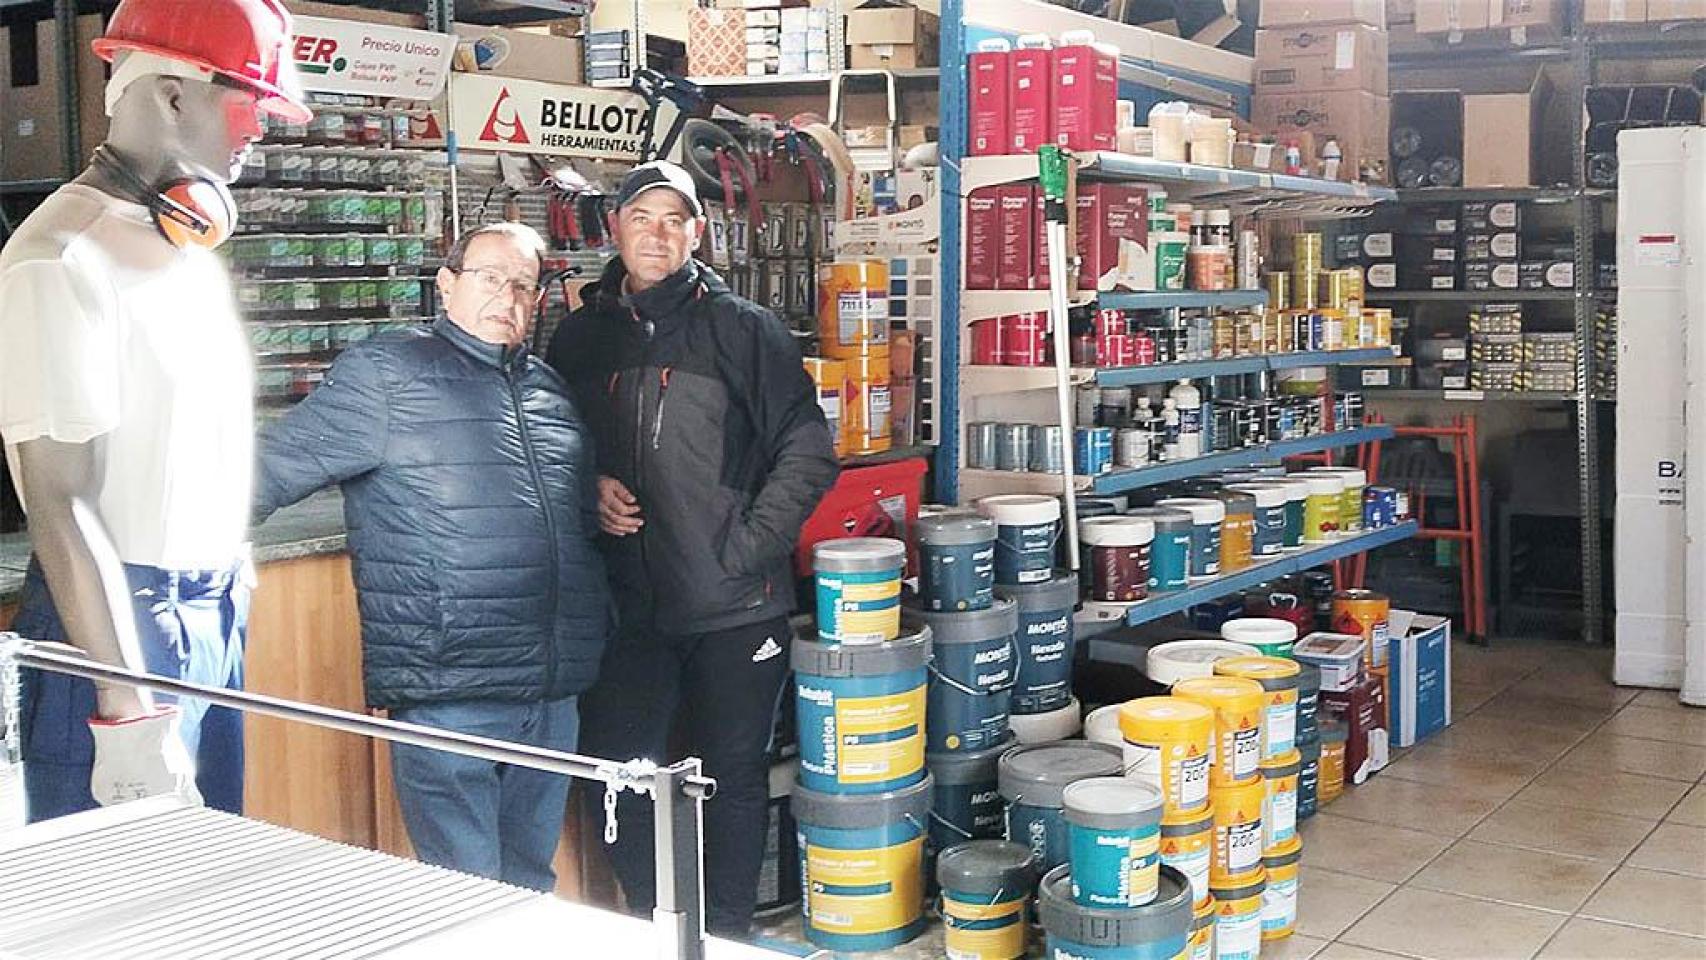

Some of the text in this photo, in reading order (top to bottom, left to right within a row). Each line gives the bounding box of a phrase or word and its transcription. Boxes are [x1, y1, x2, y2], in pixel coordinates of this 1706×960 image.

[292, 34, 338, 64] ER
[361, 36, 402, 53] Precio
[541, 99, 650, 135] BELLOTA
[1658, 461, 1682, 477] B
